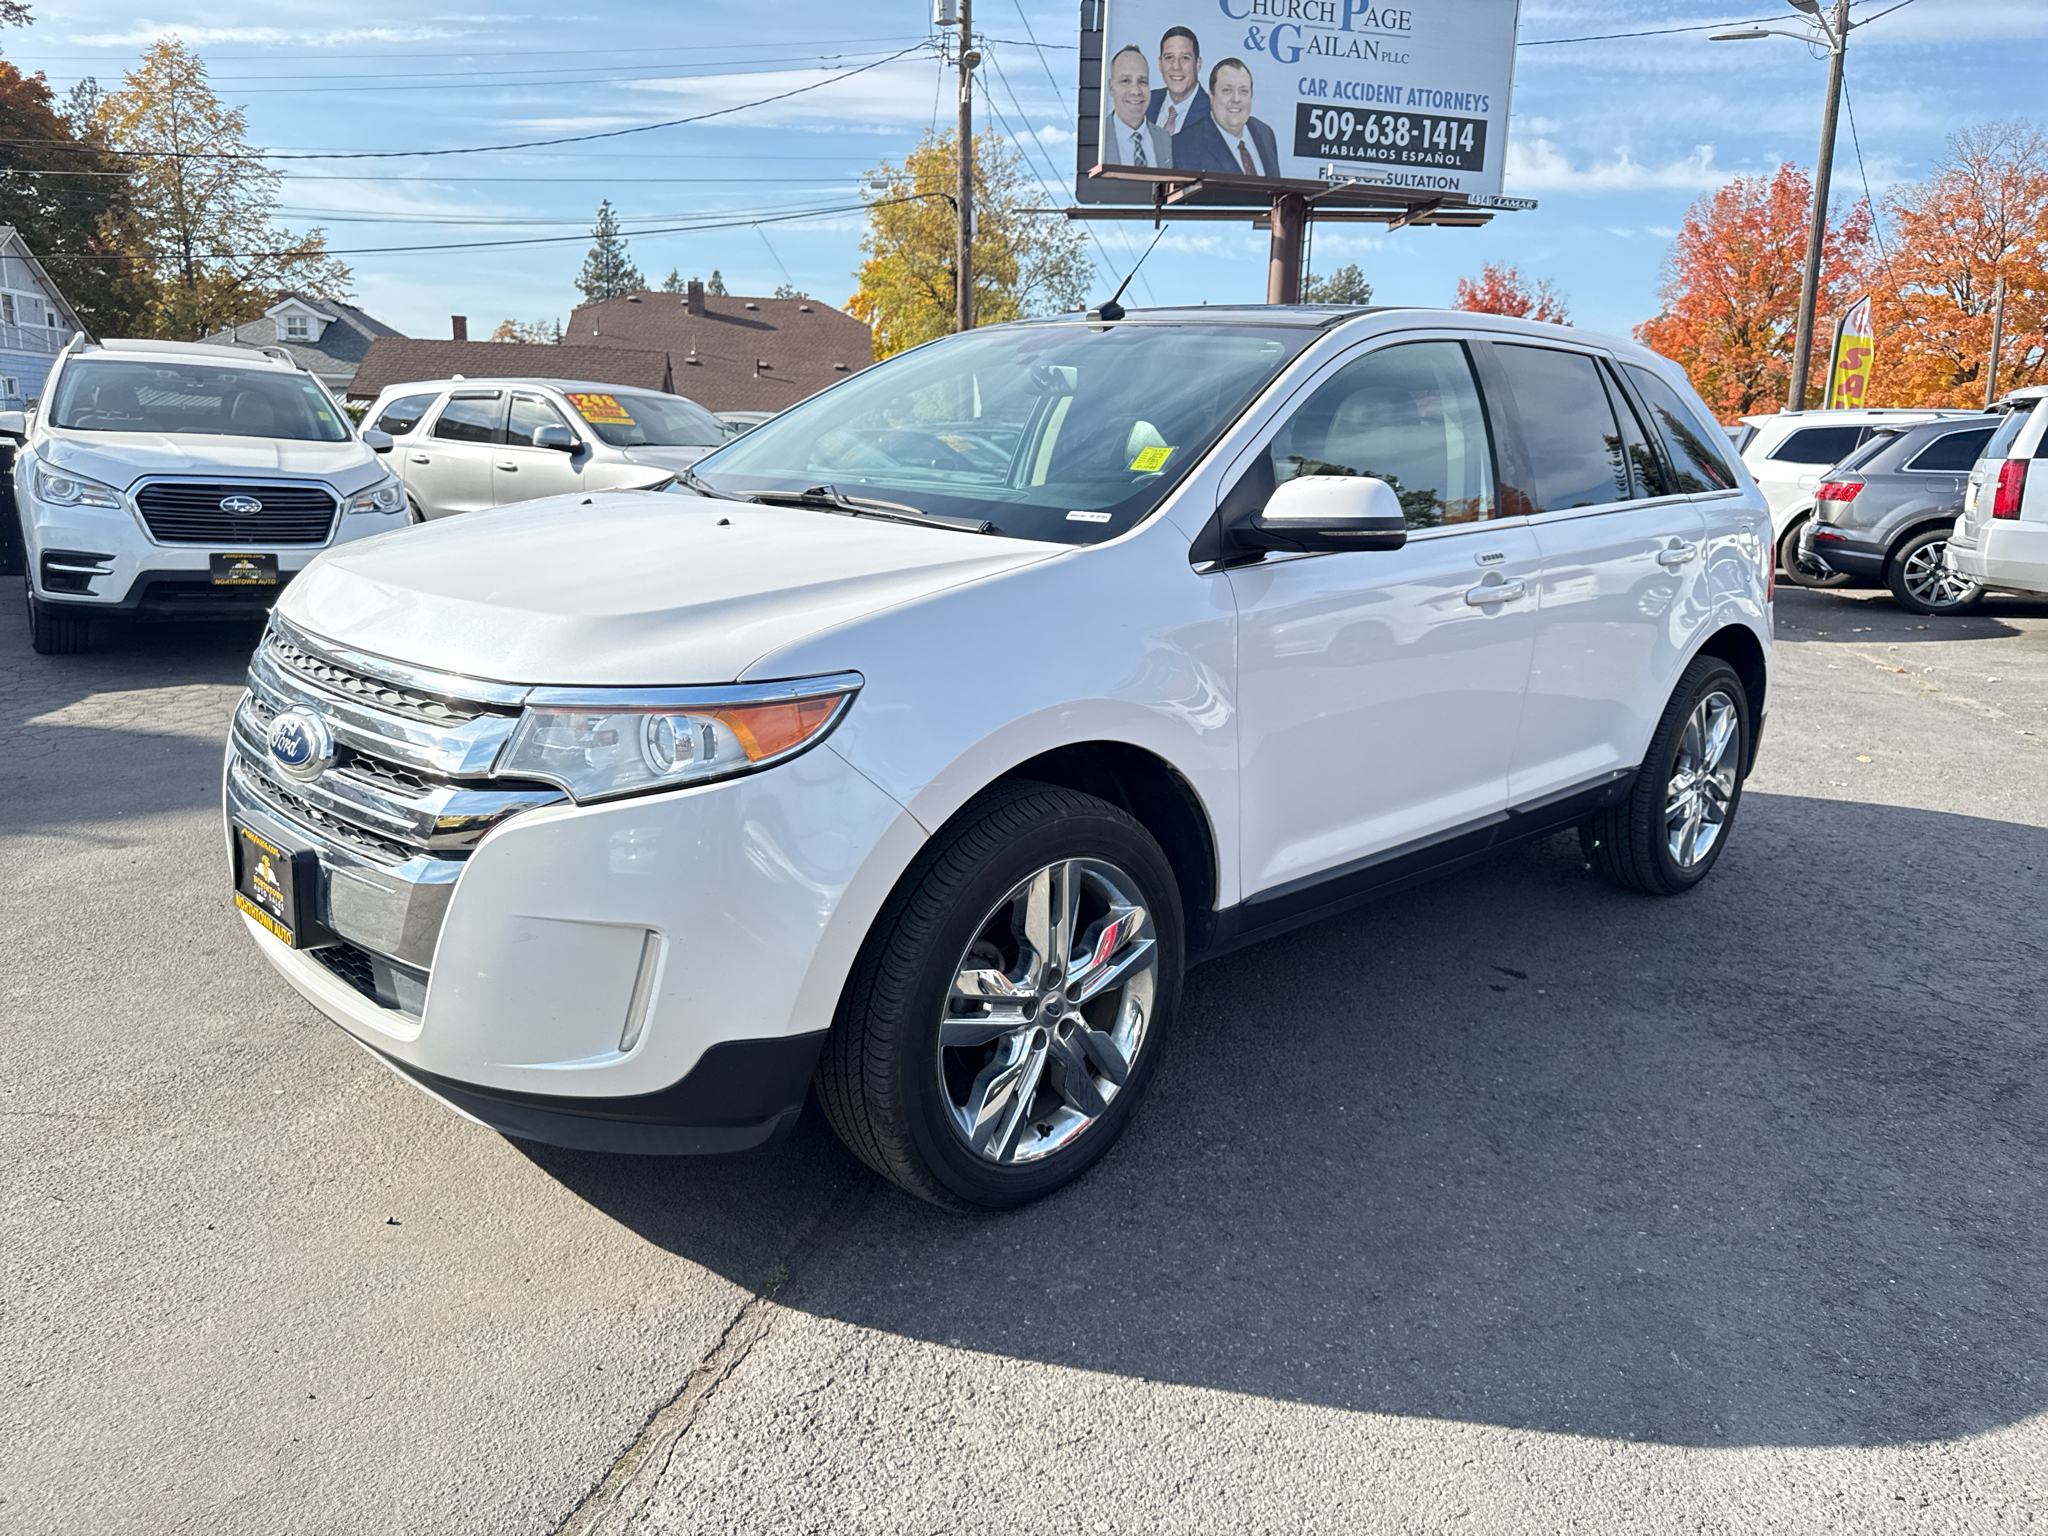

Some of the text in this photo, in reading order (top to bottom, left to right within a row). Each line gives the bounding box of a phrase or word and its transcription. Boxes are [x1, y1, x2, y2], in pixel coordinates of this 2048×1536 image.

[1338, 0, 1412, 33] PAGE
[1269, 23, 1380, 64] GAILAN
[1381, 51, 1410, 65] PLLC
[1298, 77, 1490, 113] CAR ACCIDENT ATTORNEYS
[1307, 109, 1474, 152] 509-638-1414
[1321, 144, 1462, 166] HABLAMOS ESPAÑOL
[1355, 170, 1460, 190] SULTATION
[1496, 198, 1534, 209] LAMAR
[1836, 347, 1871, 410] SA
[271, 731, 302, 757] Ford
[268, 894, 285, 911] SALES
[235, 893, 292, 946] NORTHTOWN AUTO
